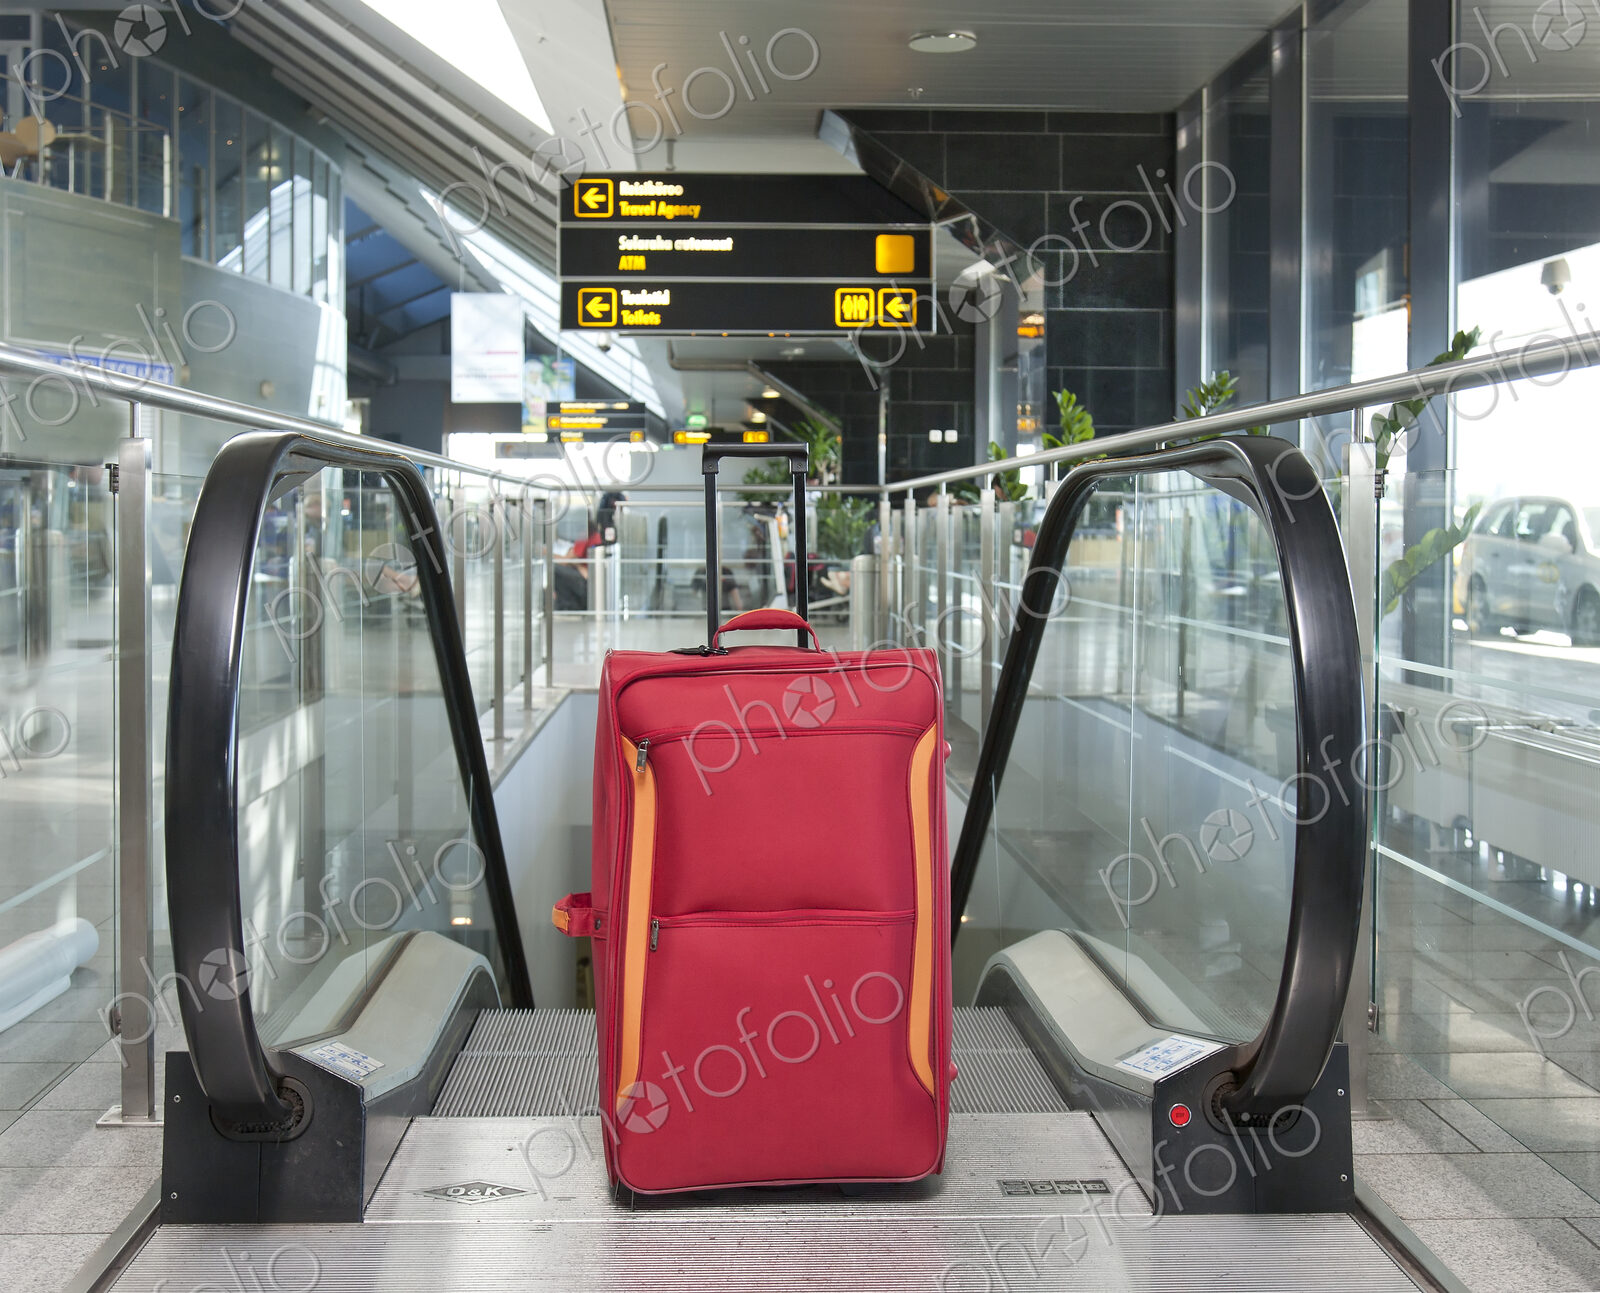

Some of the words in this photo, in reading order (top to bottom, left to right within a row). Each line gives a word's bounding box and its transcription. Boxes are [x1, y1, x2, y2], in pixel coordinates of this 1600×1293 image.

[619, 200, 656, 216] Travel
[657, 201, 701, 219] Agency
[619, 255, 646, 271] ATM
[621, 309, 661, 325] Toilets
